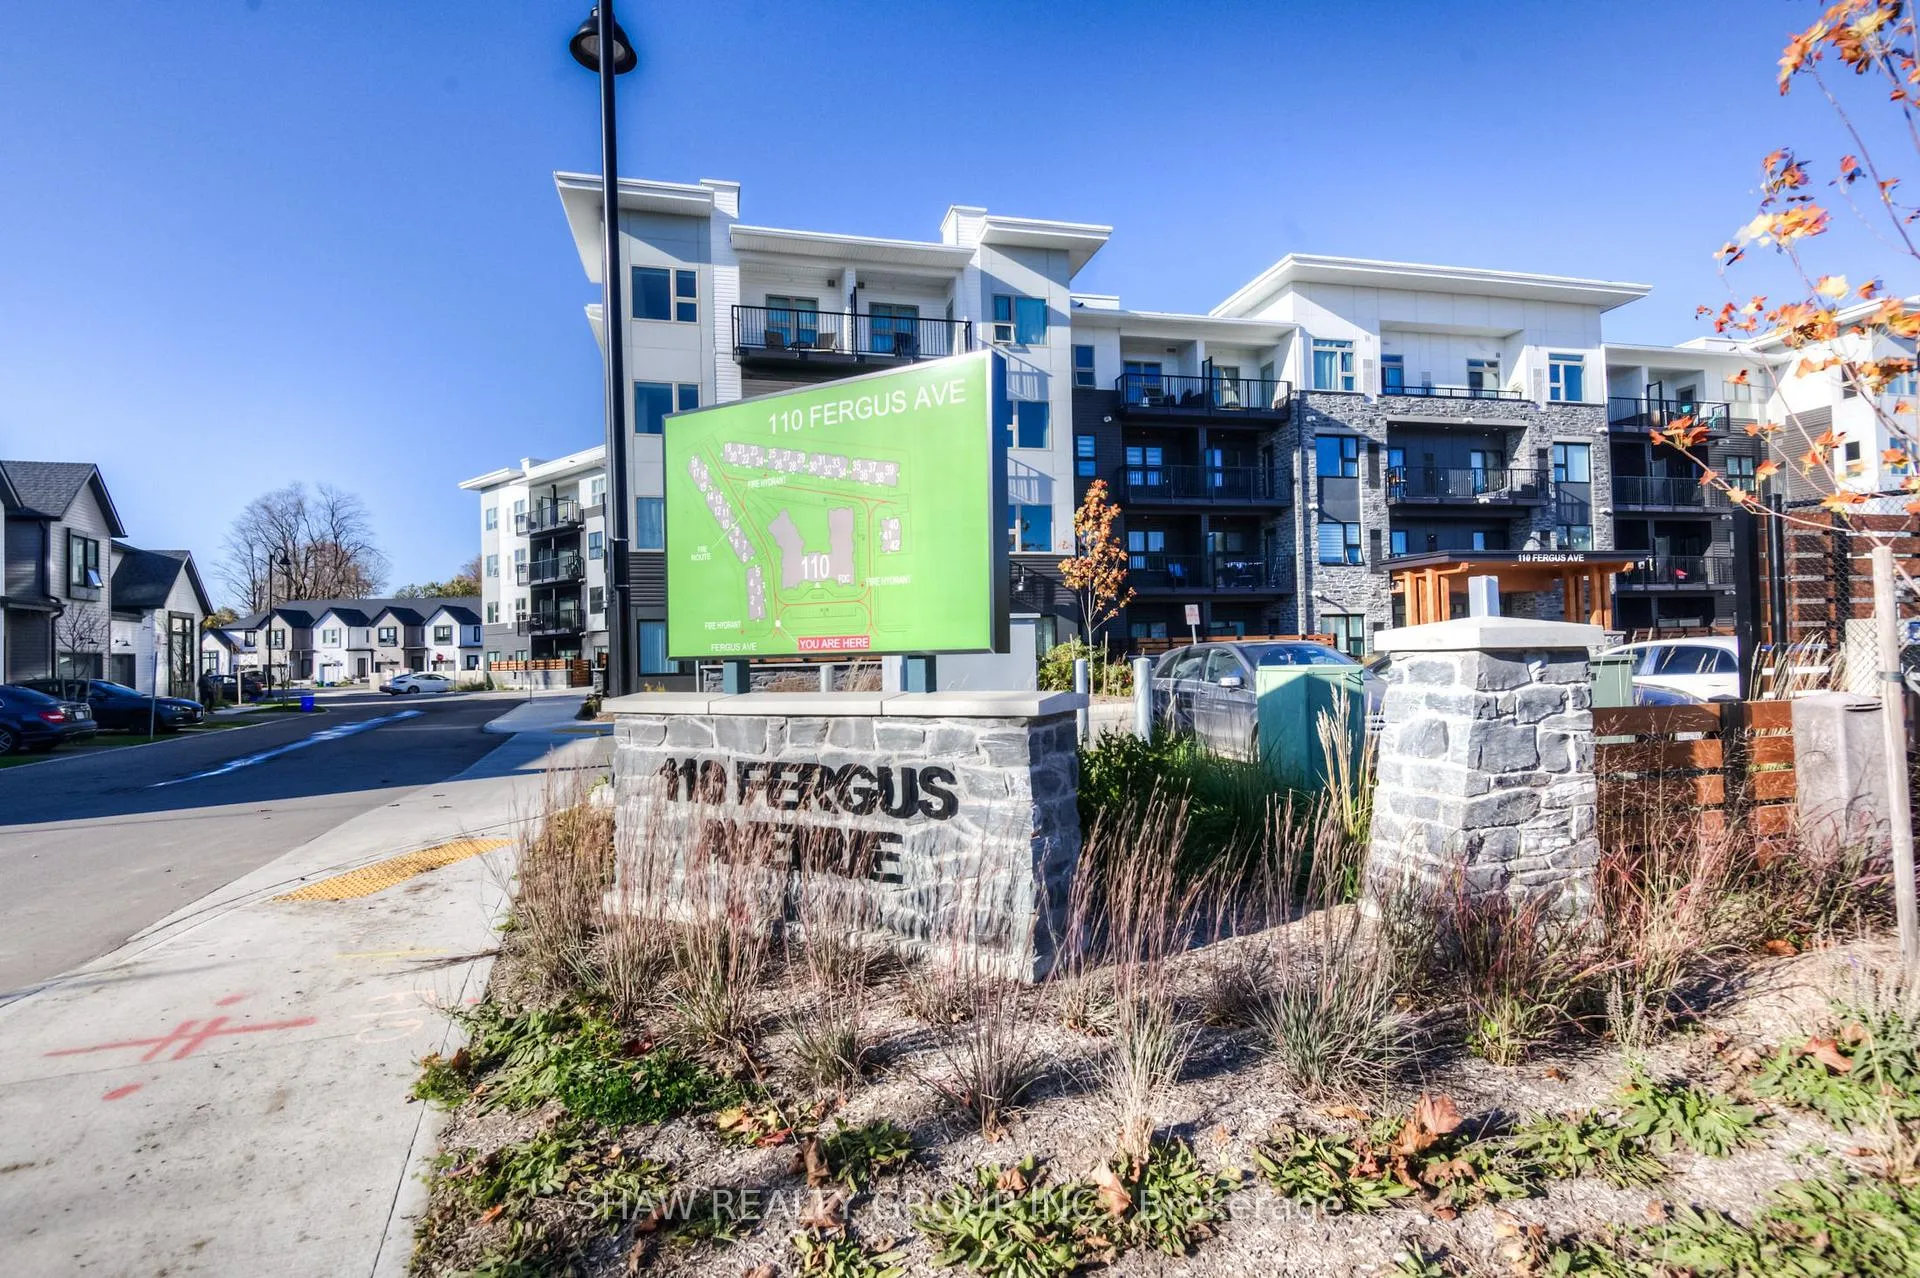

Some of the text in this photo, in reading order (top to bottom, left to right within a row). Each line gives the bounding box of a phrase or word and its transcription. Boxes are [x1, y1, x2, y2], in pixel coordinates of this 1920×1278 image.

[768, 379, 966, 434] 110 FERGUS AVE
[801, 554, 830, 580] 110
[1532, 554, 1566, 562] FERGUS
[711, 642, 757, 651] FERGUS AVE
[800, 638, 868, 648] YOU ARE HERE
[658, 757, 959, 820] 110 FERGUS
